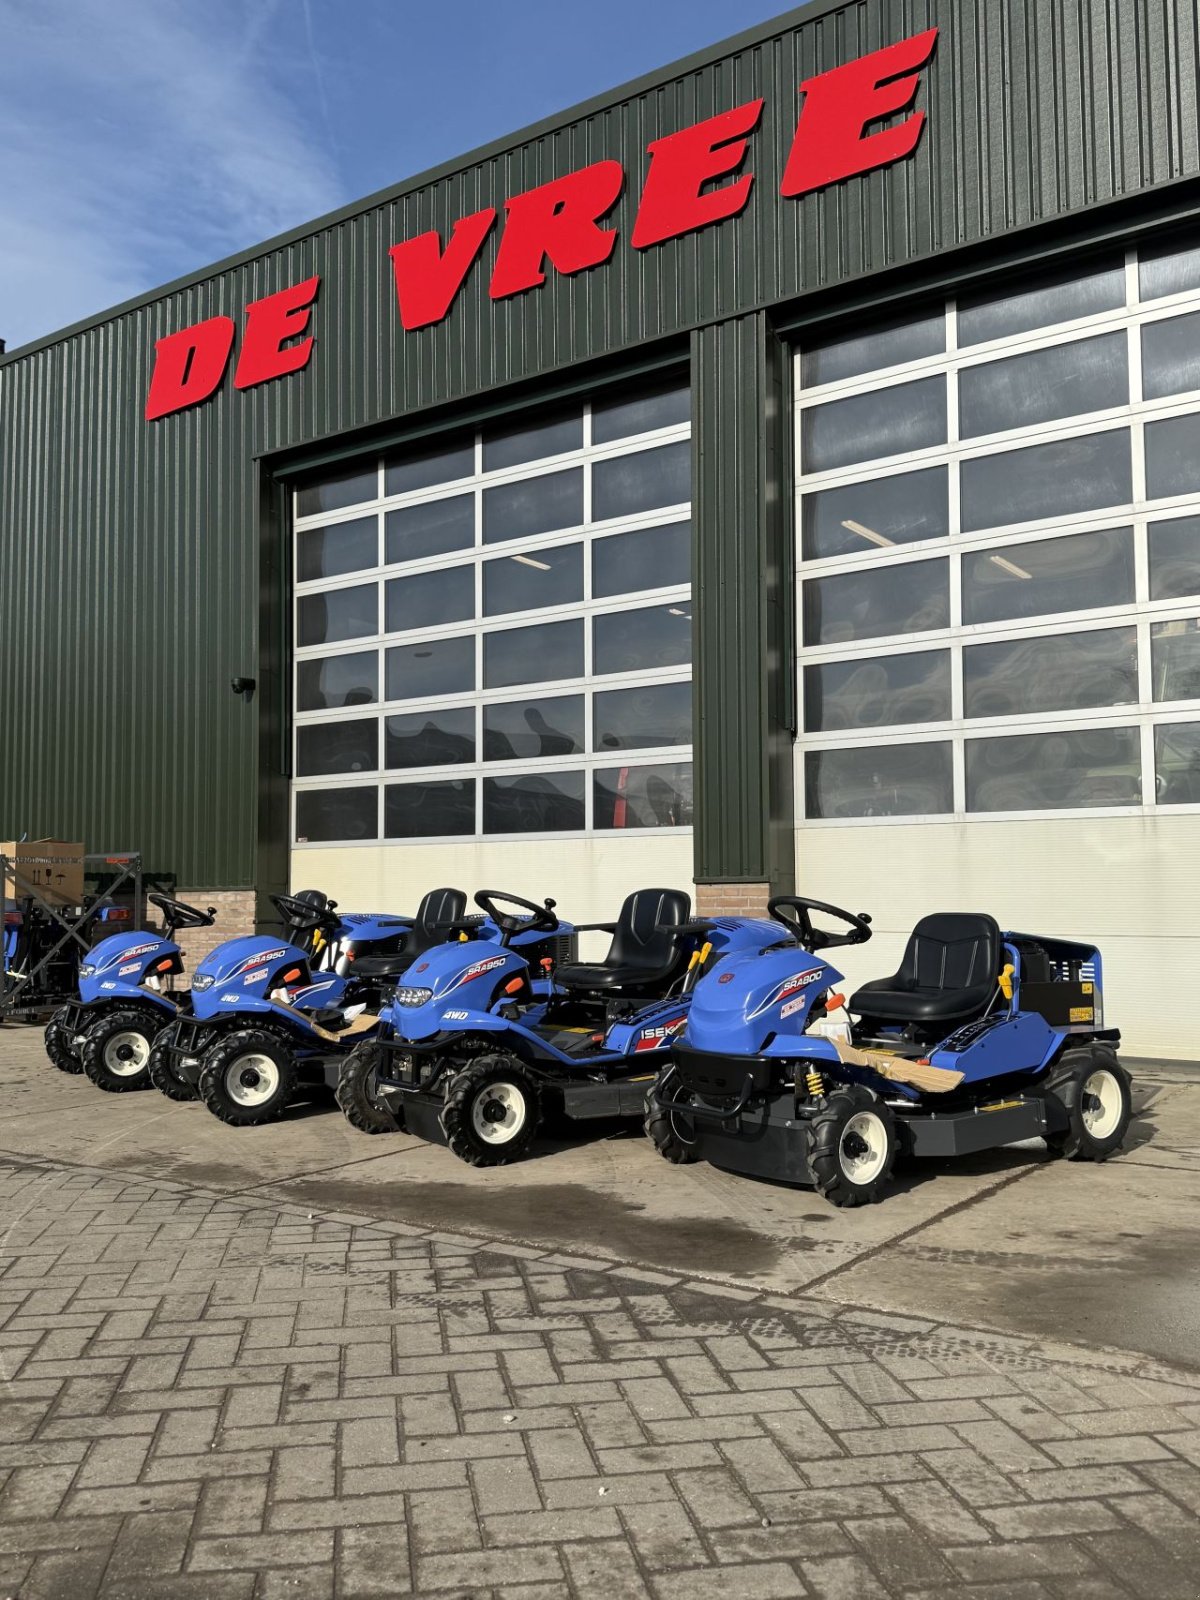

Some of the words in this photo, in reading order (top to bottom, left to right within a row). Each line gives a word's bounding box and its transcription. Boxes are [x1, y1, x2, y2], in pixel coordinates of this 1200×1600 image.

[145, 276, 321, 421] DE
[388, 28, 938, 331] VREE
[248, 950, 286, 964] SRA950
[467, 957, 506, 976] SRA950
[783, 970, 823, 991] SRA800
[221, 994, 240, 1003] 4WD
[442, 1010, 469, 1020] 4WD
[640, 1025, 679, 1040] ISEK
